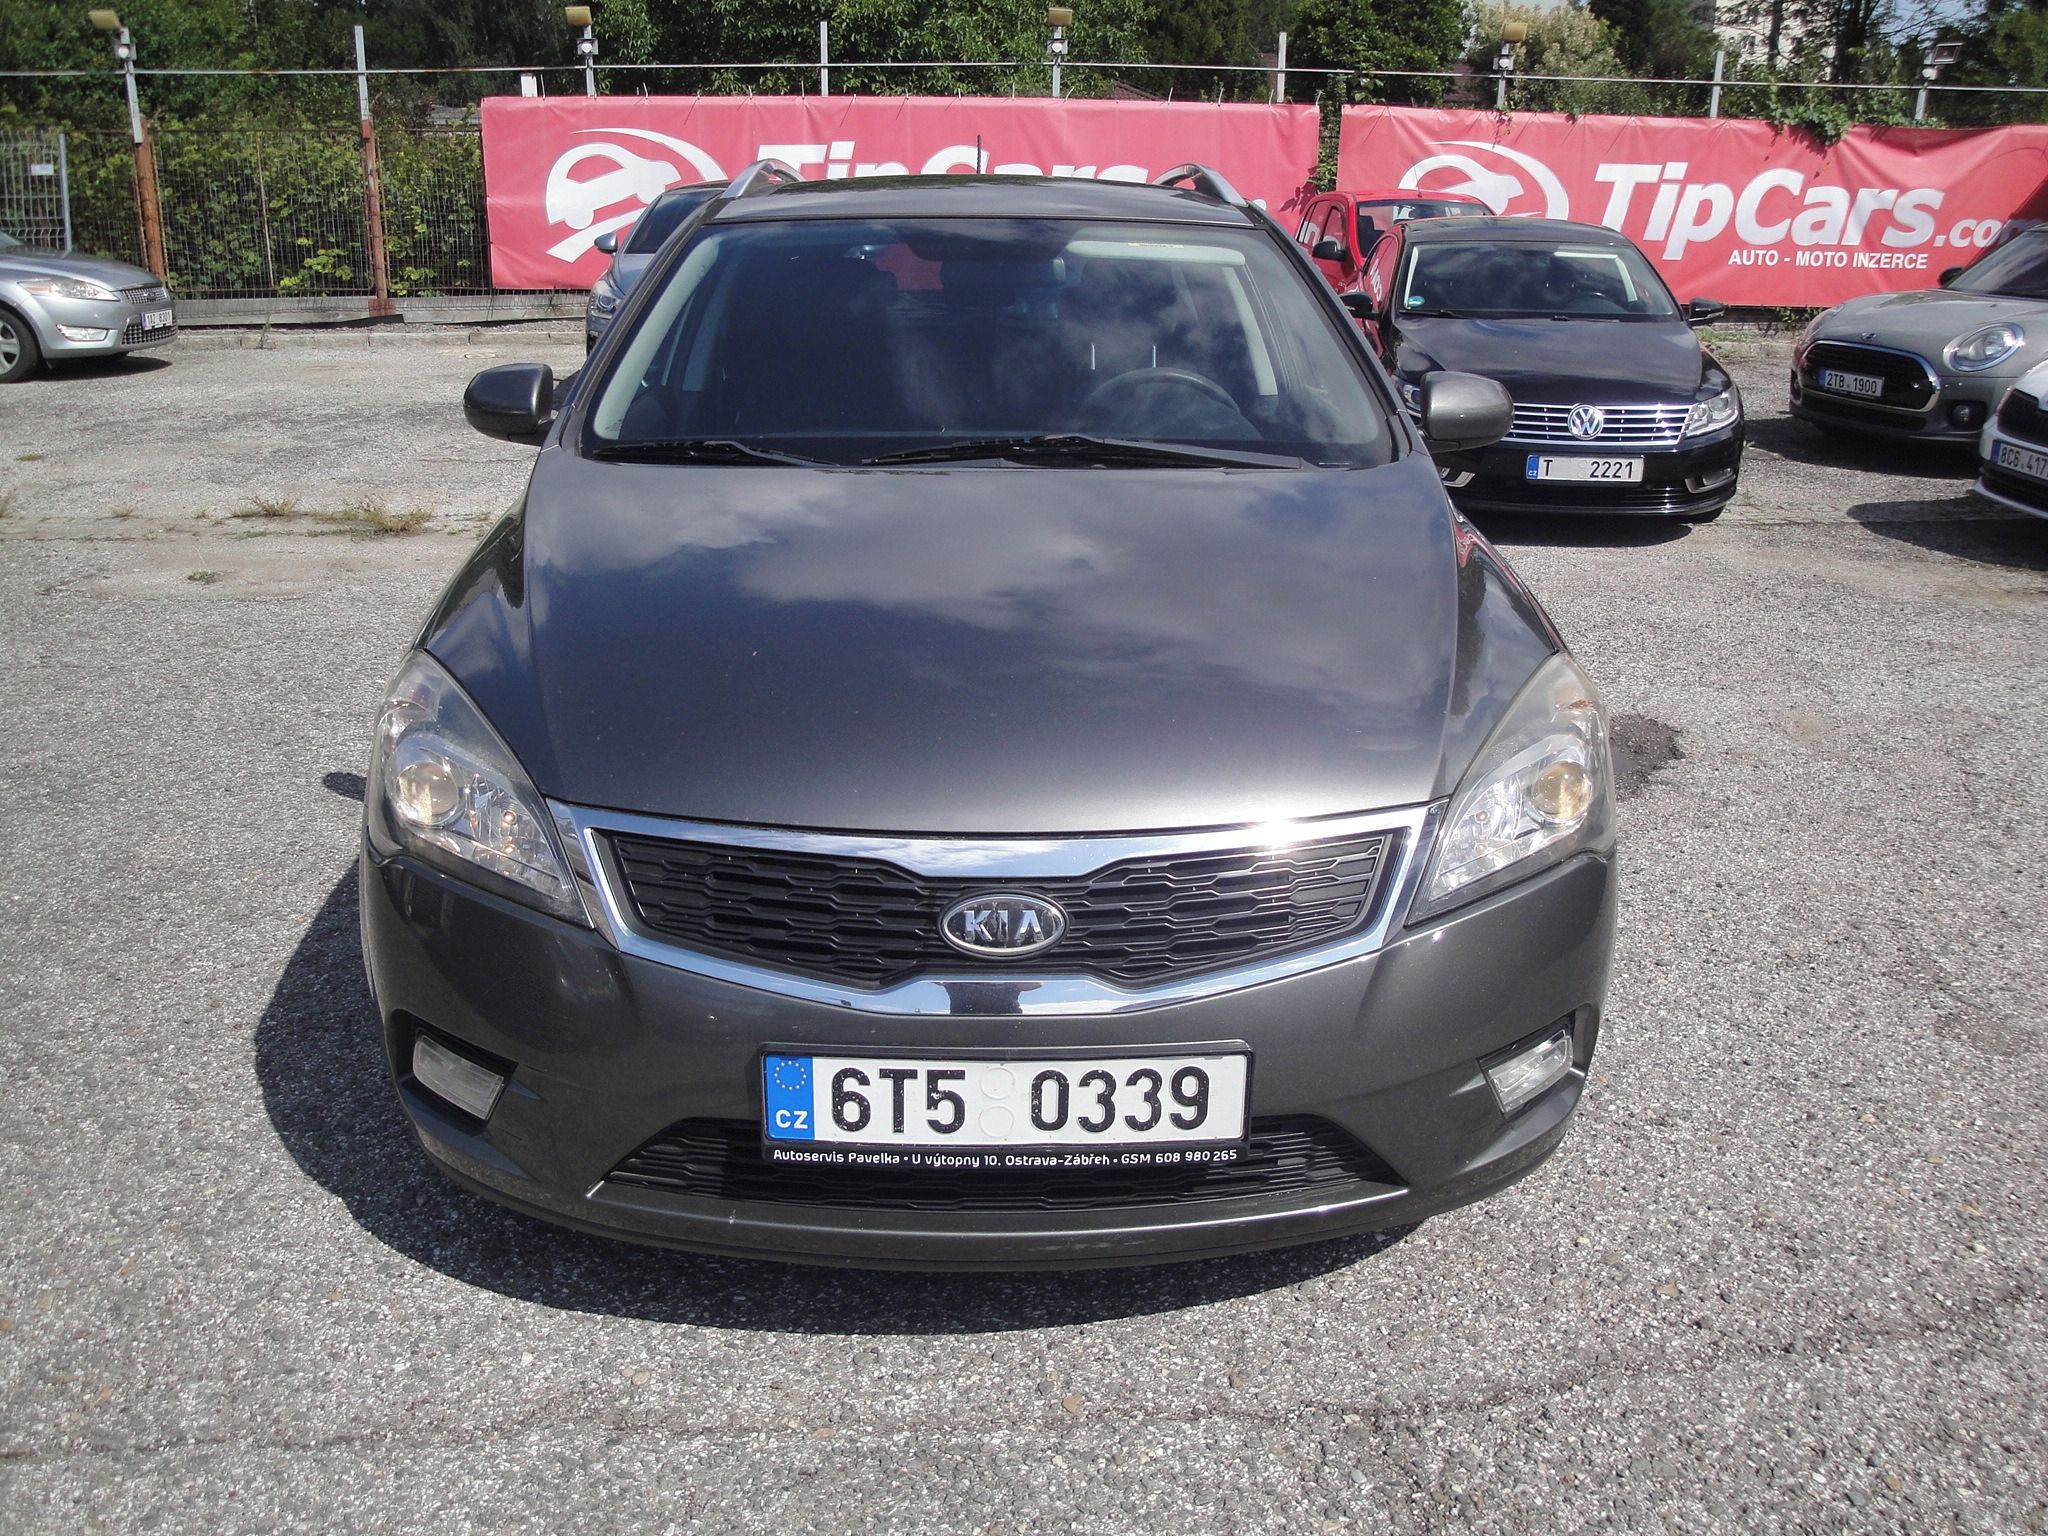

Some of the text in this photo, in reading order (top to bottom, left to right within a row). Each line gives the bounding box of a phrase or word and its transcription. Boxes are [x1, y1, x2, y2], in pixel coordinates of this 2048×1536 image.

[1728, 249, 1778, 266] AUTO
[1796, 250, 1847, 268] MOTO
[1853, 252, 1928, 269] INZERCE
[1827, 373, 1877, 393] 2TB 1900
[1544, 459, 1633, 479] T 2221
[964, 910, 1044, 941] KIA
[832, 1066, 1210, 1134] 6T5 0339
[775, 1110, 808, 1129] CZ
[773, 1149, 844, 1163] Autoservis
[848, 1153, 900, 1164] Pavelka
[912, 1153, 921, 1165] U
[925, 1153, 980, 1168] výtopny
[1005, 1153, 1110, 1166] Ostrava-Zábřeh
[1121, 1153, 1151, 1165] GSM
[1155, 1152, 1181, 1164] 608
[1185, 1151, 1210, 1162] 980
[1213, 1149, 1238, 1161] 265
